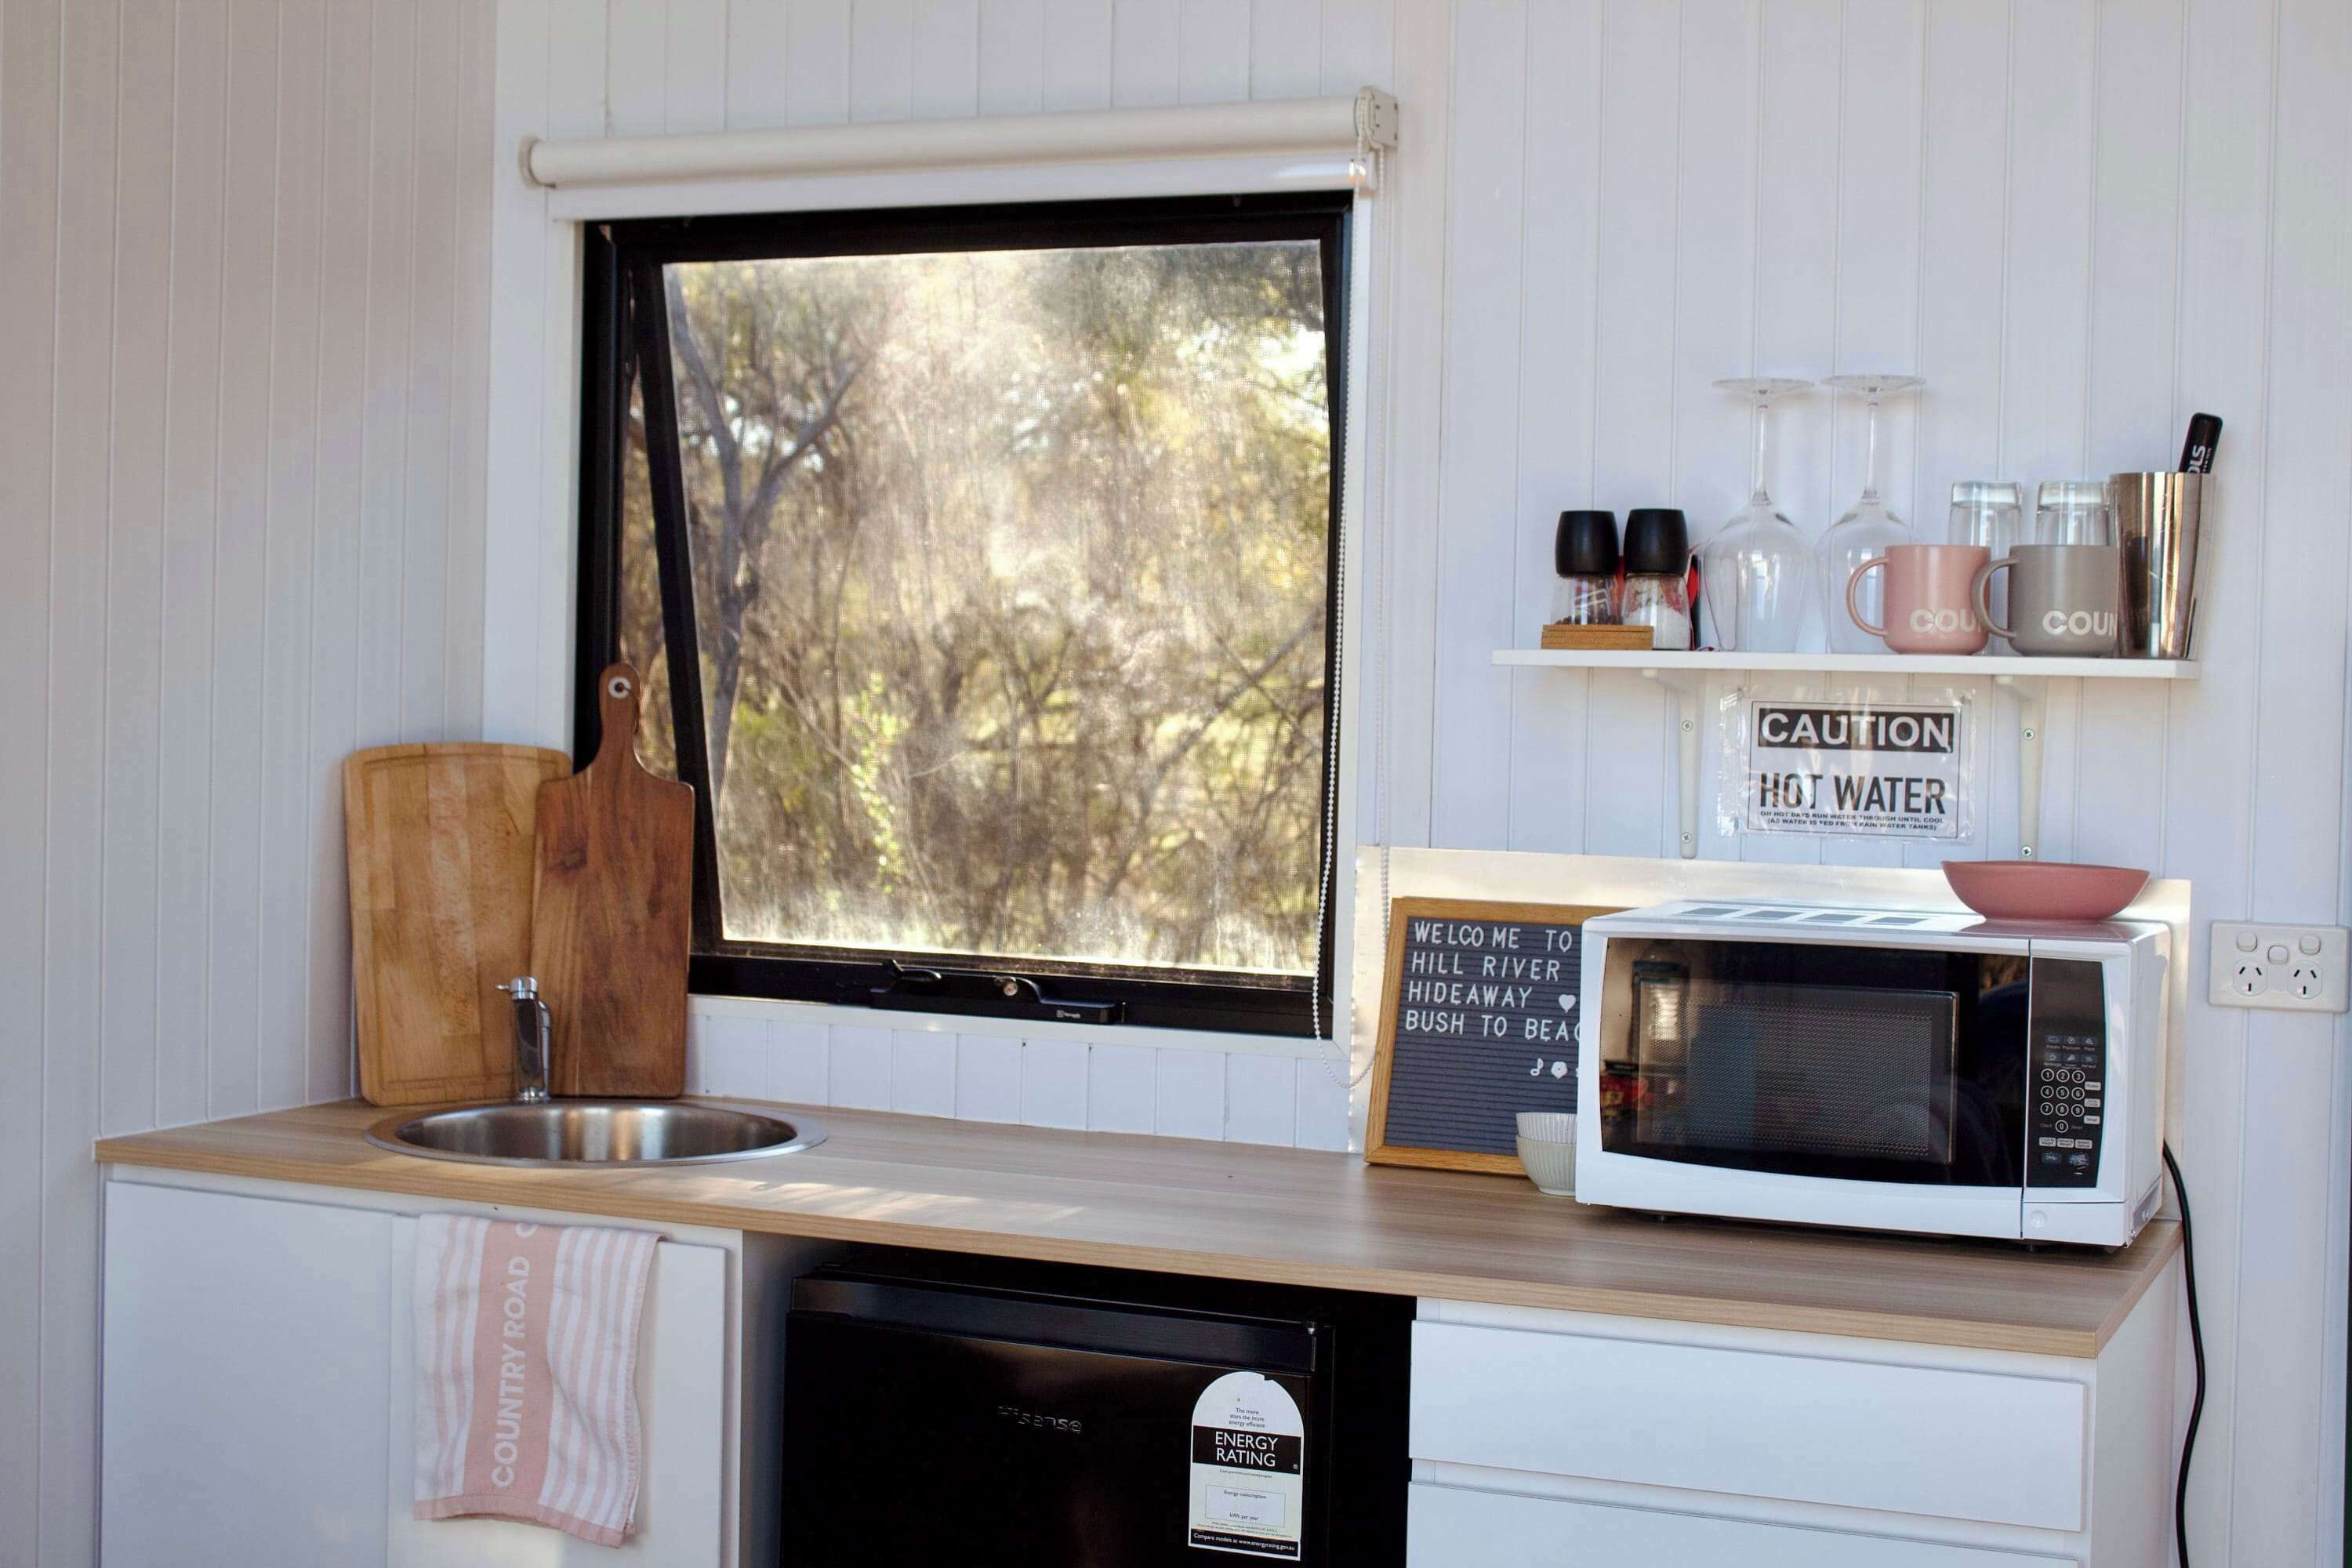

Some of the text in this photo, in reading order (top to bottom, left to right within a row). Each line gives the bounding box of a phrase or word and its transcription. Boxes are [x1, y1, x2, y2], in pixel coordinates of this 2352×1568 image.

[1910, 608, 1980, 633] COU
[1762, 713, 1950, 748] CAUTION
[1761, 772, 1945, 814] HOT WATER
[1414, 921, 1572, 953] WELCOME TO
[1411, 951, 1560, 982] HILL RIVER
[1408, 980, 1533, 1008] HIDEAWAY
[1406, 1010, 1465, 1035] BUSH
[1481, 1015, 1507, 1037] TO
[491, 1256, 530, 1488] COUNTRY ROAD
[1215, 1431, 1279, 1450] ENERGY
[1216, 1447, 1276, 1467] RATING
[1193, 1533, 1215, 1542] Compare
